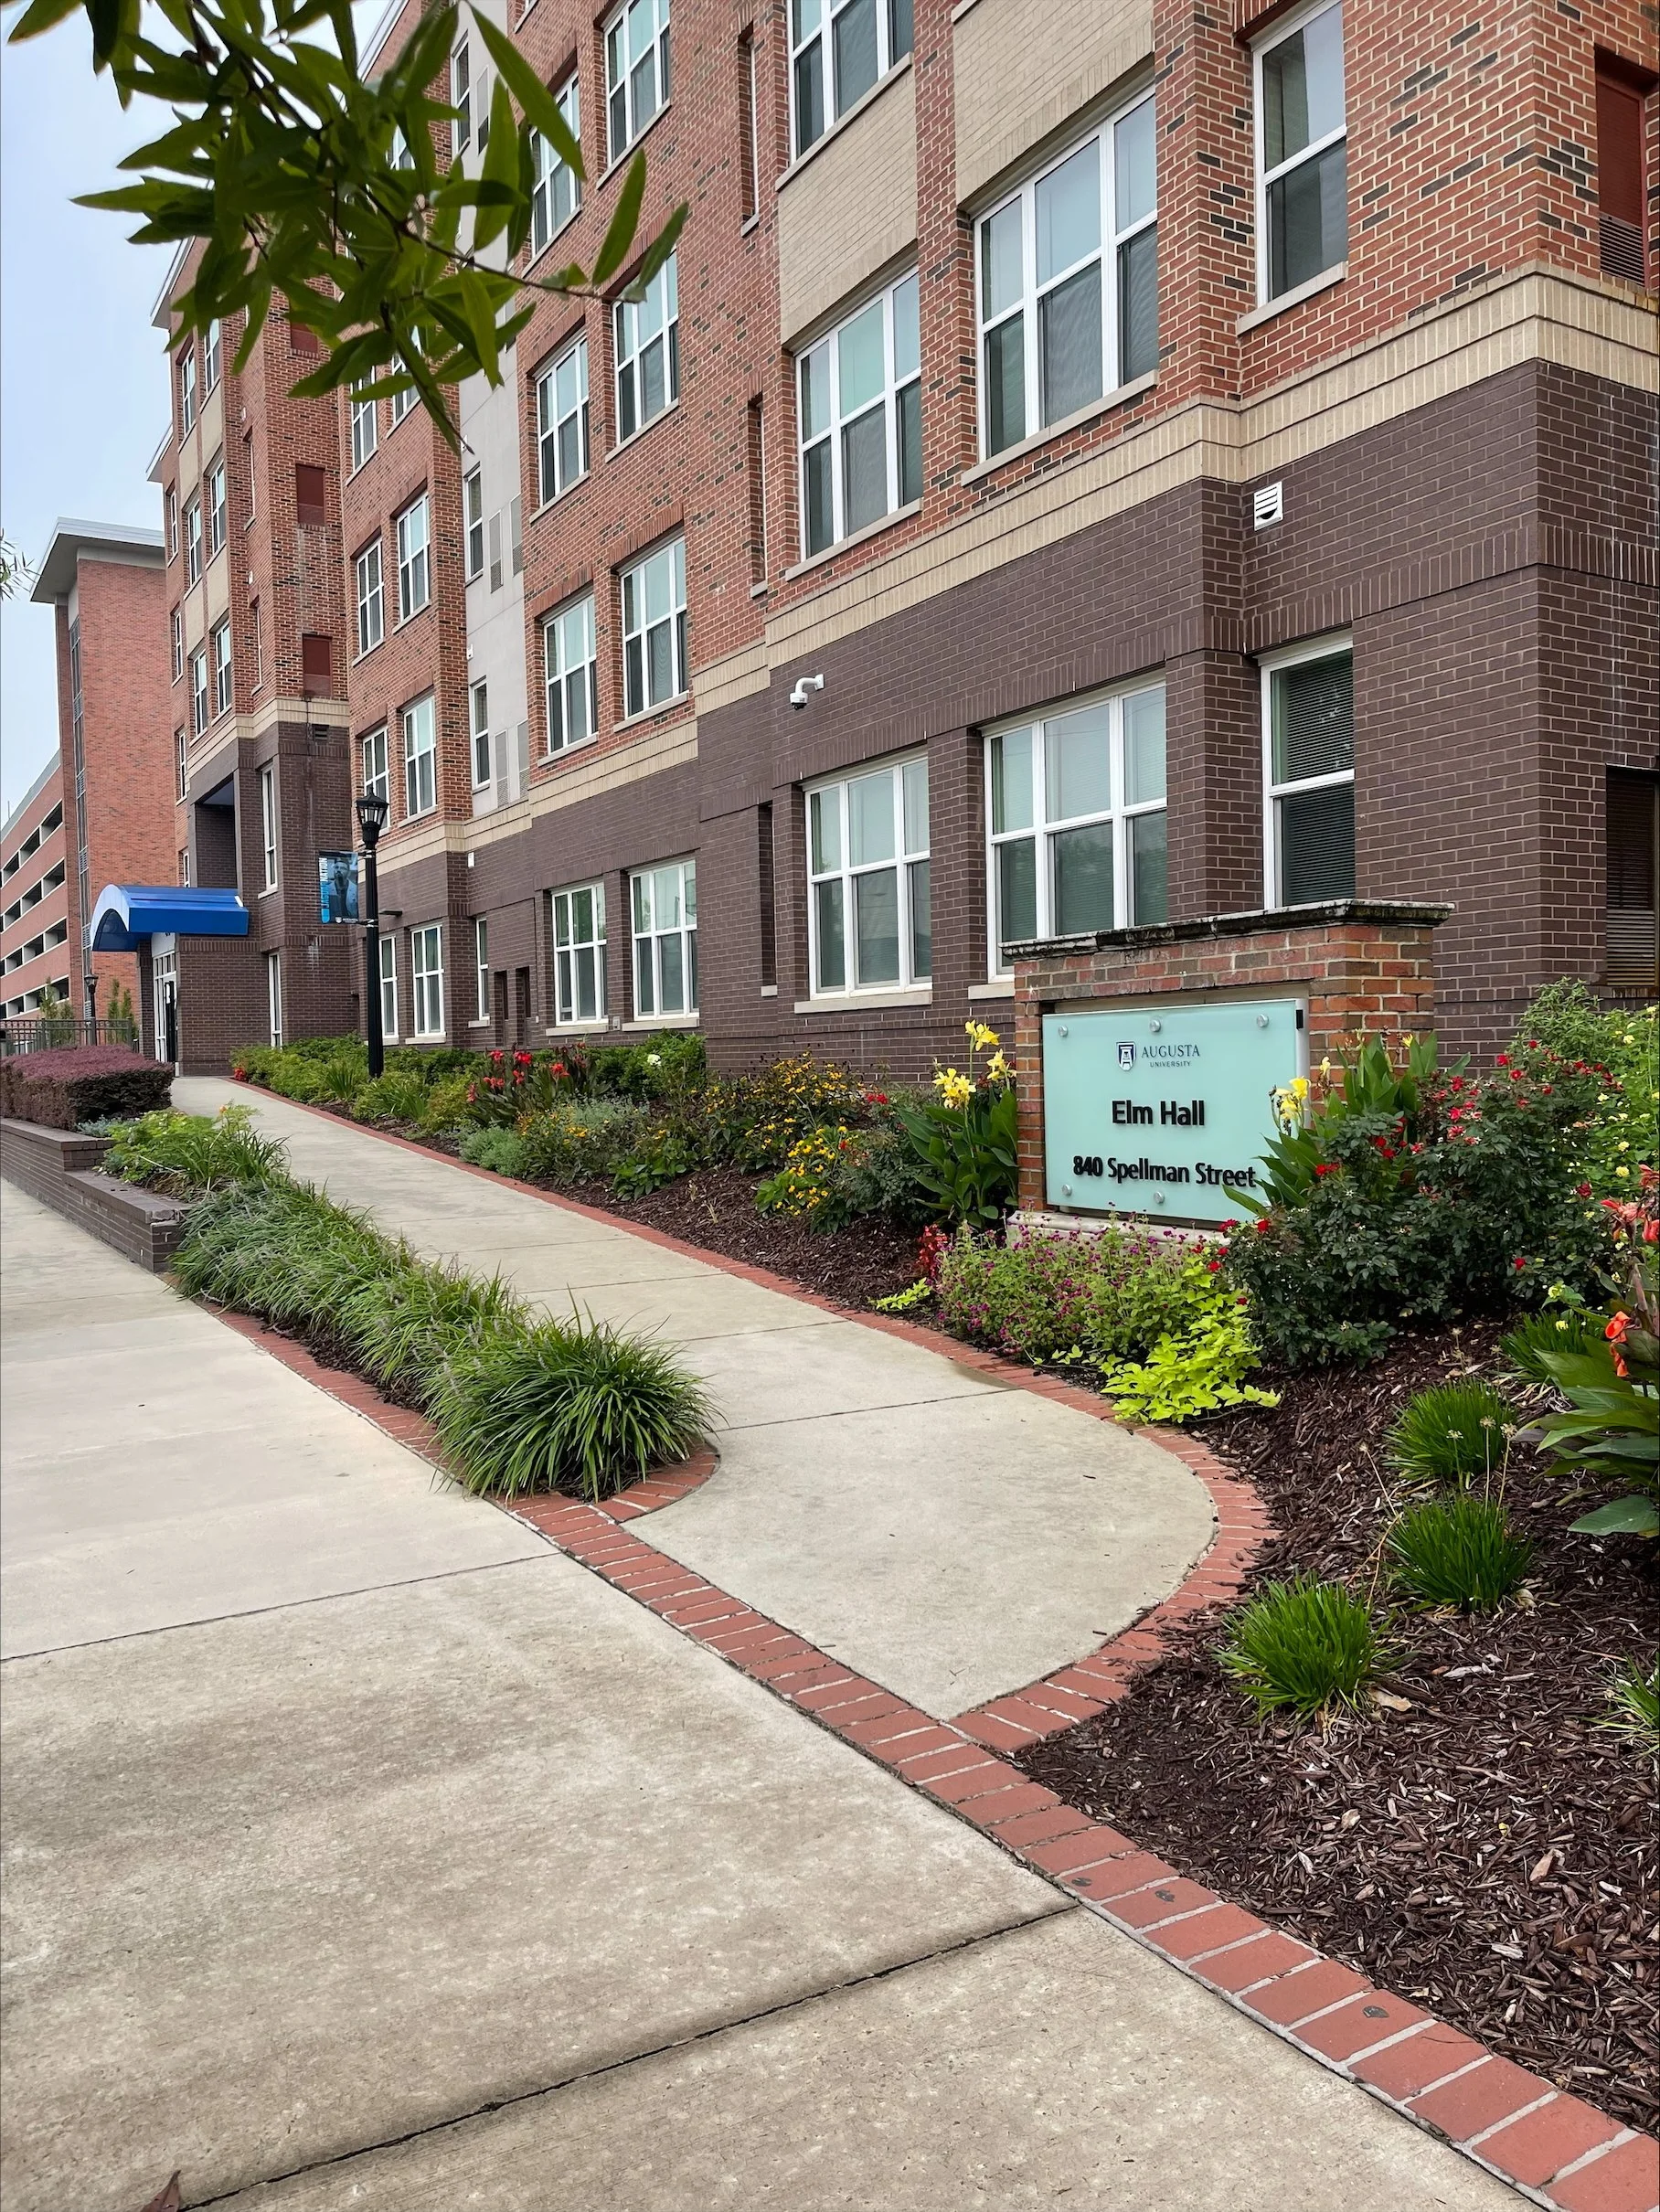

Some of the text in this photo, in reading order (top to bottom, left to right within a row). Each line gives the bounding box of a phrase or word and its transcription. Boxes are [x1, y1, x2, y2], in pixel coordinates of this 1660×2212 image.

[1142, 1045, 1200, 1058] AUGUSTA
[1112, 1100, 1205, 1125] Elm Hall
[1073, 1156, 1256, 1187] 840 Spellman Street
